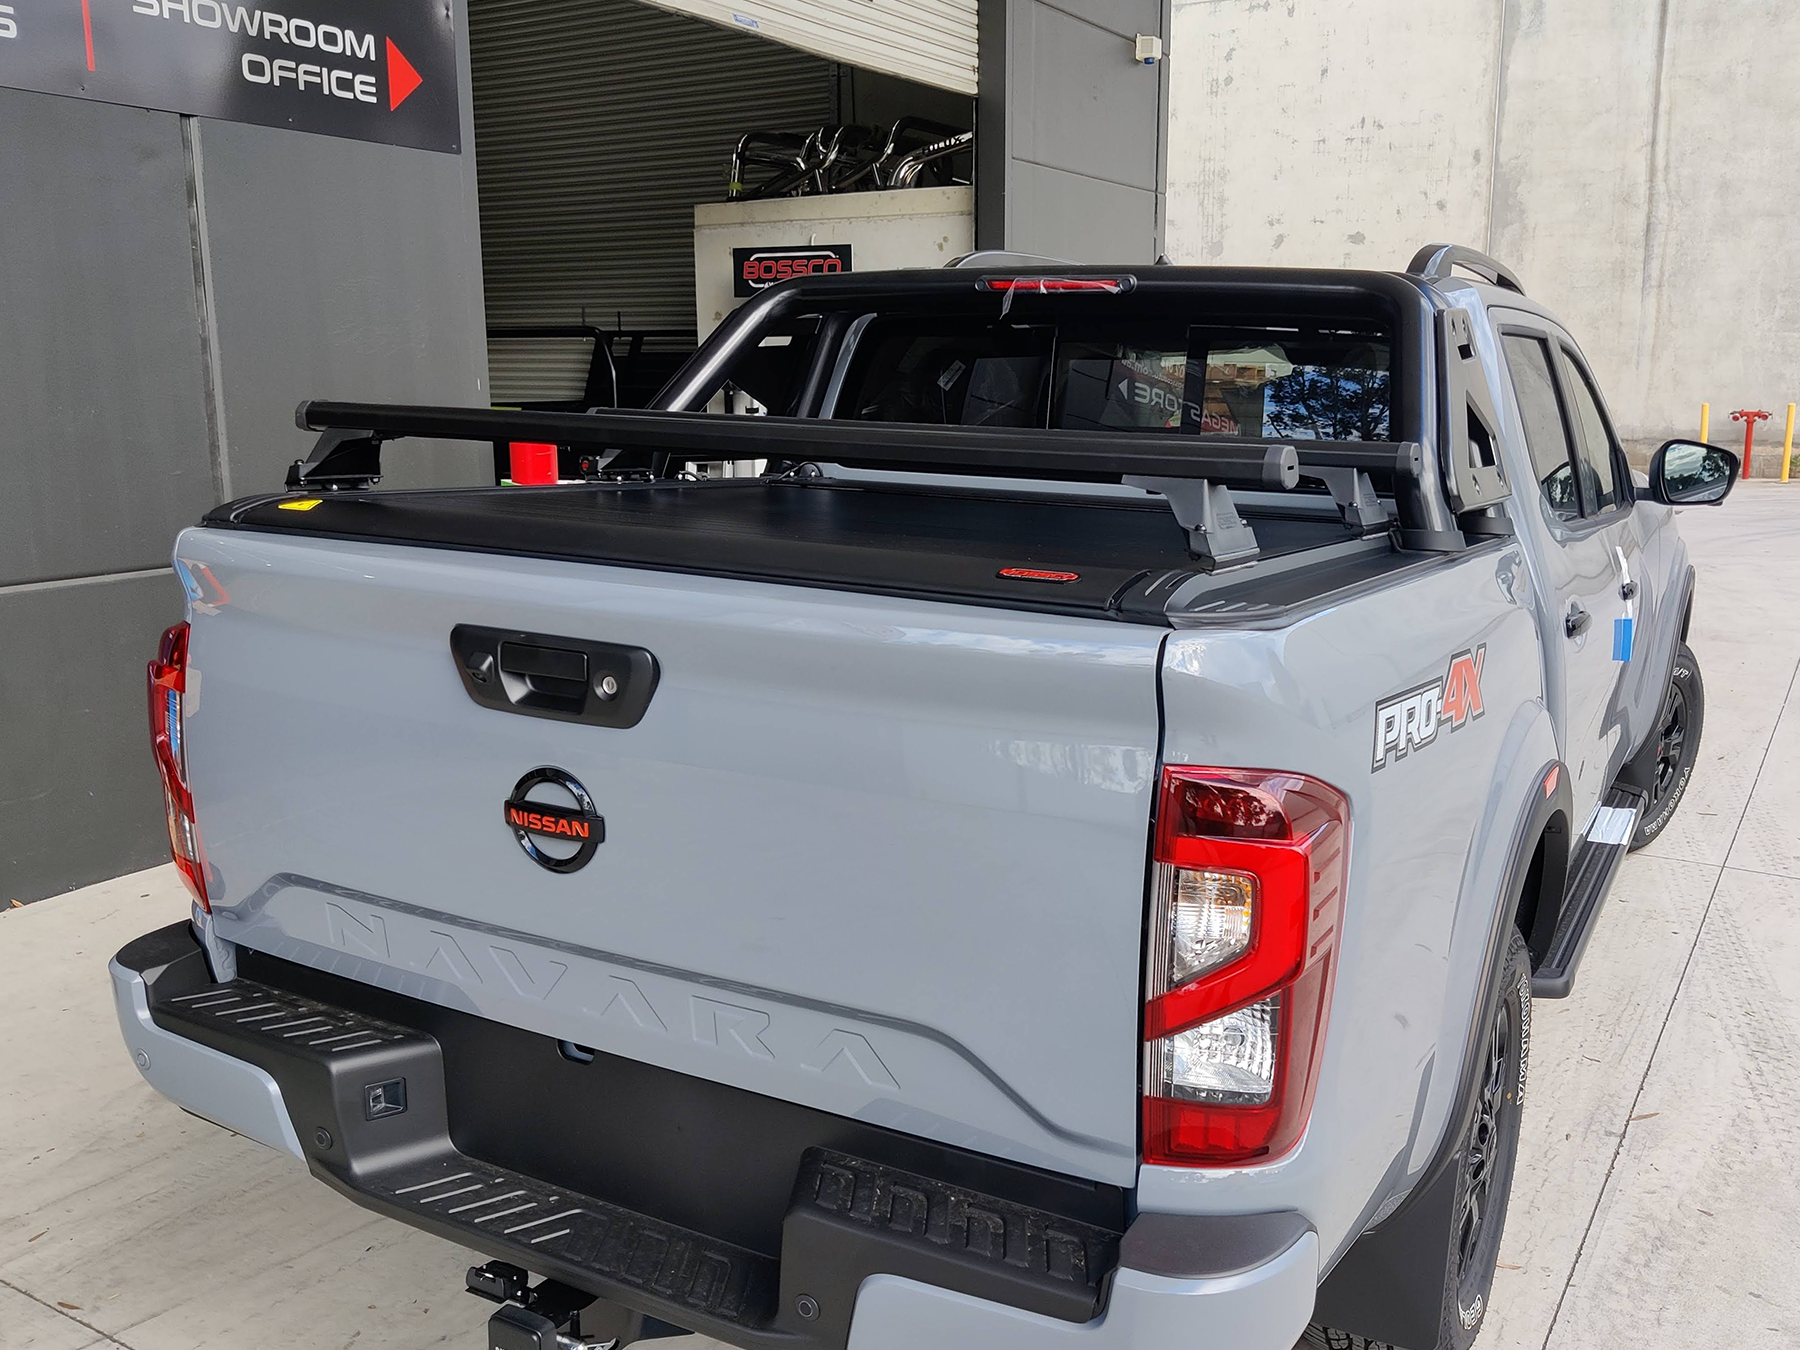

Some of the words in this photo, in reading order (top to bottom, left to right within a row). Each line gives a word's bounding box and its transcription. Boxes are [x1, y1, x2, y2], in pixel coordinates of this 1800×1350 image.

[133, 0, 377, 61] SHOWROOM
[241, 53, 378, 104] OFFICE
[743, 258, 842, 279] BOSSCO
[1371, 642, 1487, 774] PRO-4X
[510, 808, 589, 838] NISSAN
[1644, 767, 1691, 836] YOKOHAMA
[325, 902, 901, 1090] NAVARA
